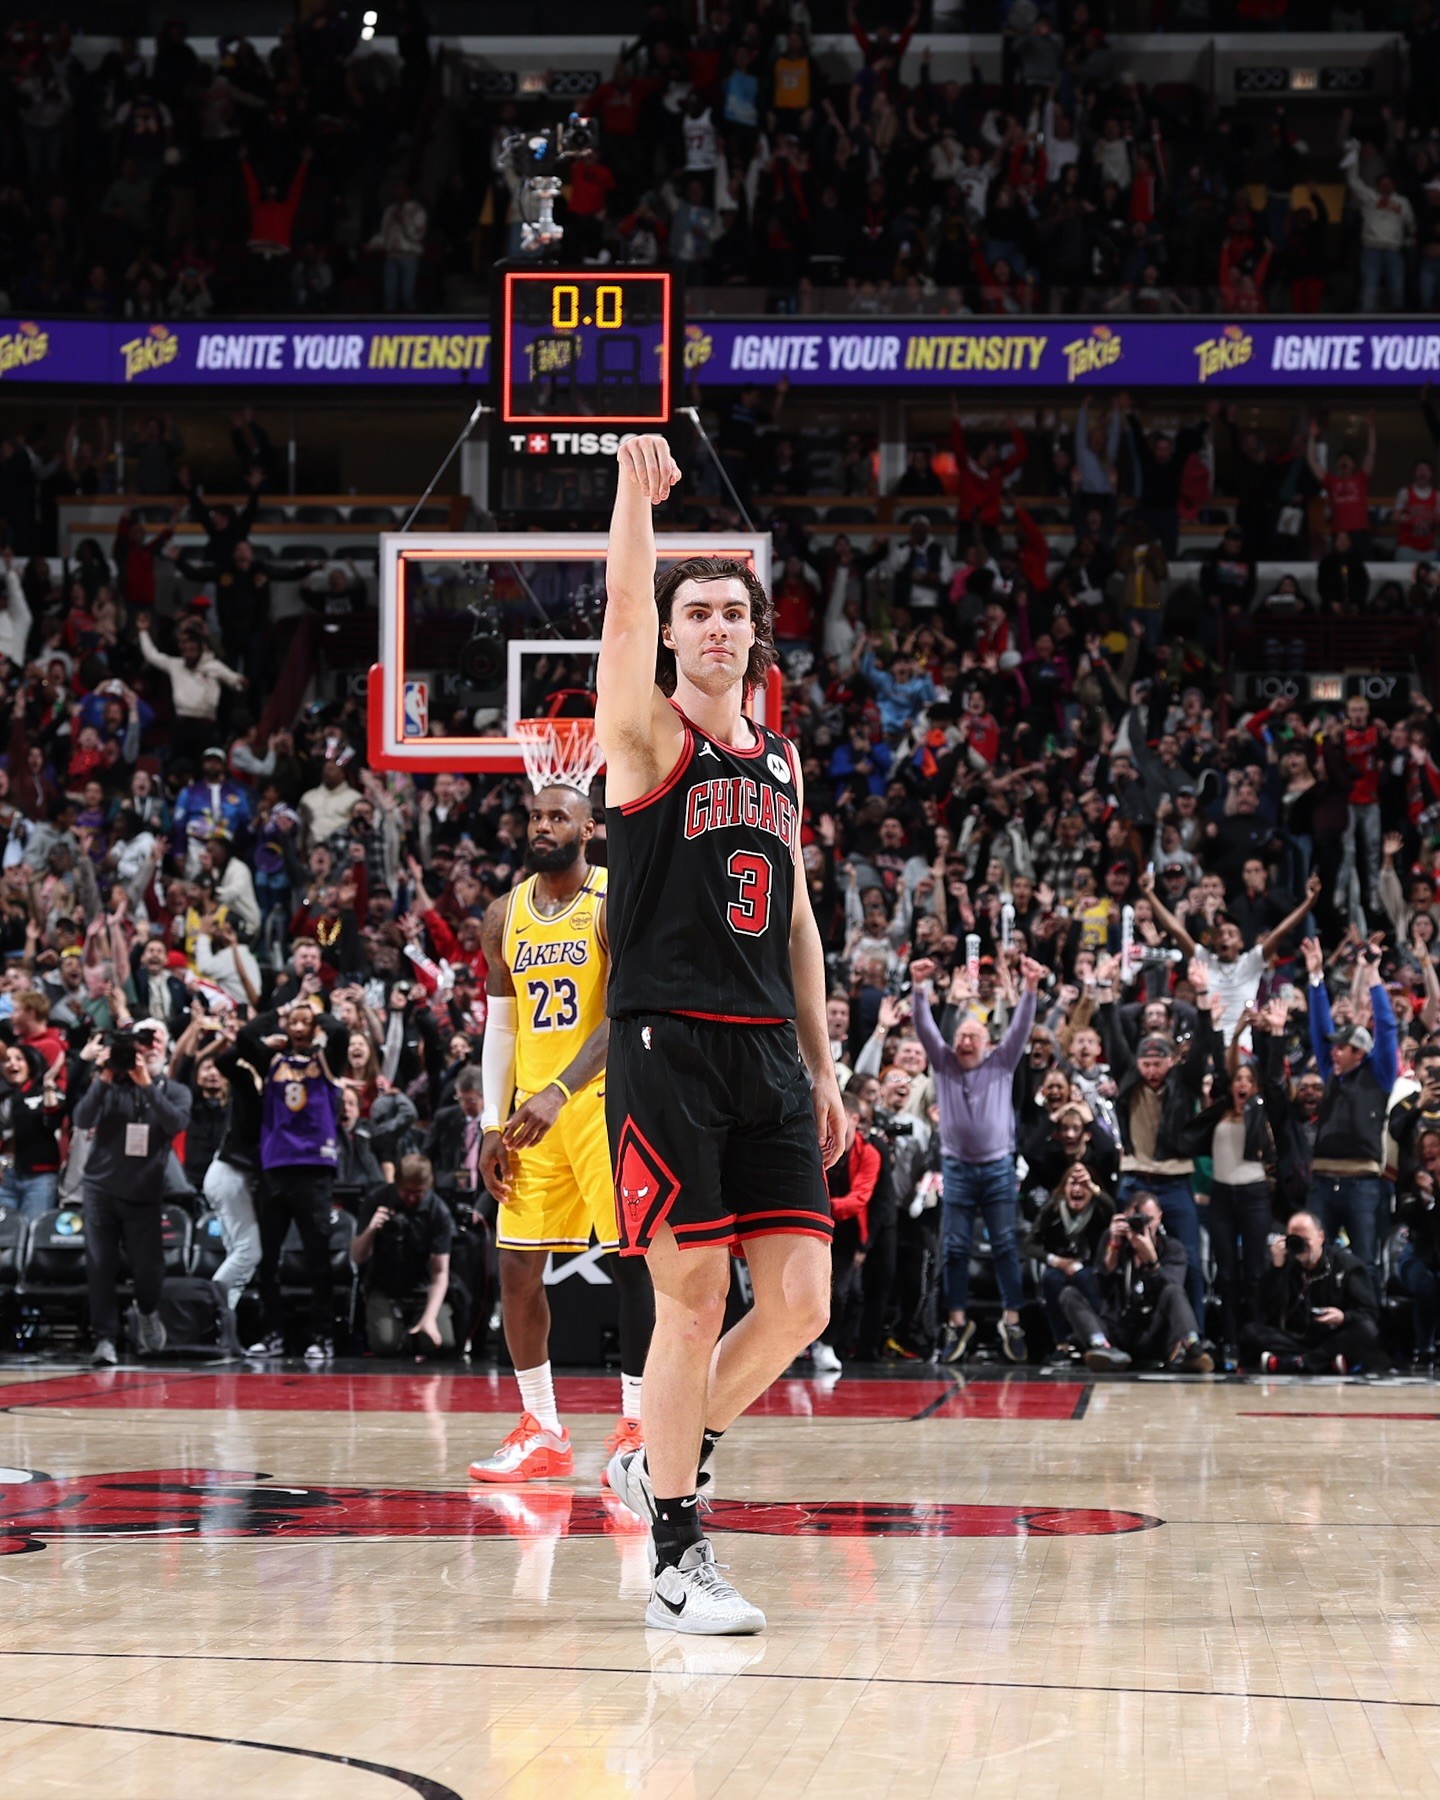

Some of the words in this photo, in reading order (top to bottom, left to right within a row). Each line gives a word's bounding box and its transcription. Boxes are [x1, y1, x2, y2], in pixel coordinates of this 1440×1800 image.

[552, 285, 623, 329] 0.0
[119, 333, 179, 383] Takis
[196, 335, 287, 370] IGNITE
[292, 335, 365, 370] YOUR
[368, 335, 491, 370] INTENSIT
[730, 335, 822, 371] IGNITE
[828, 335, 900, 371] YOUR
[904, 336, 1047, 371] INTENSITY
[1062, 336, 1122, 384] Takis
[1193, 336, 1253, 384] Takis
[1271, 335, 1364, 371] IGNITE
[1370, 335, 1440, 371] YOUR
[551, 432, 662, 455] TISS
[1255, 676, 1300, 700] 106
[1359, 676, 1398, 700] 107
[727, 849, 773, 938] 3
[511, 939, 589, 974] LAKERS
[526, 977, 580, 1030] 23
[284, 1081, 308, 1113] 8
